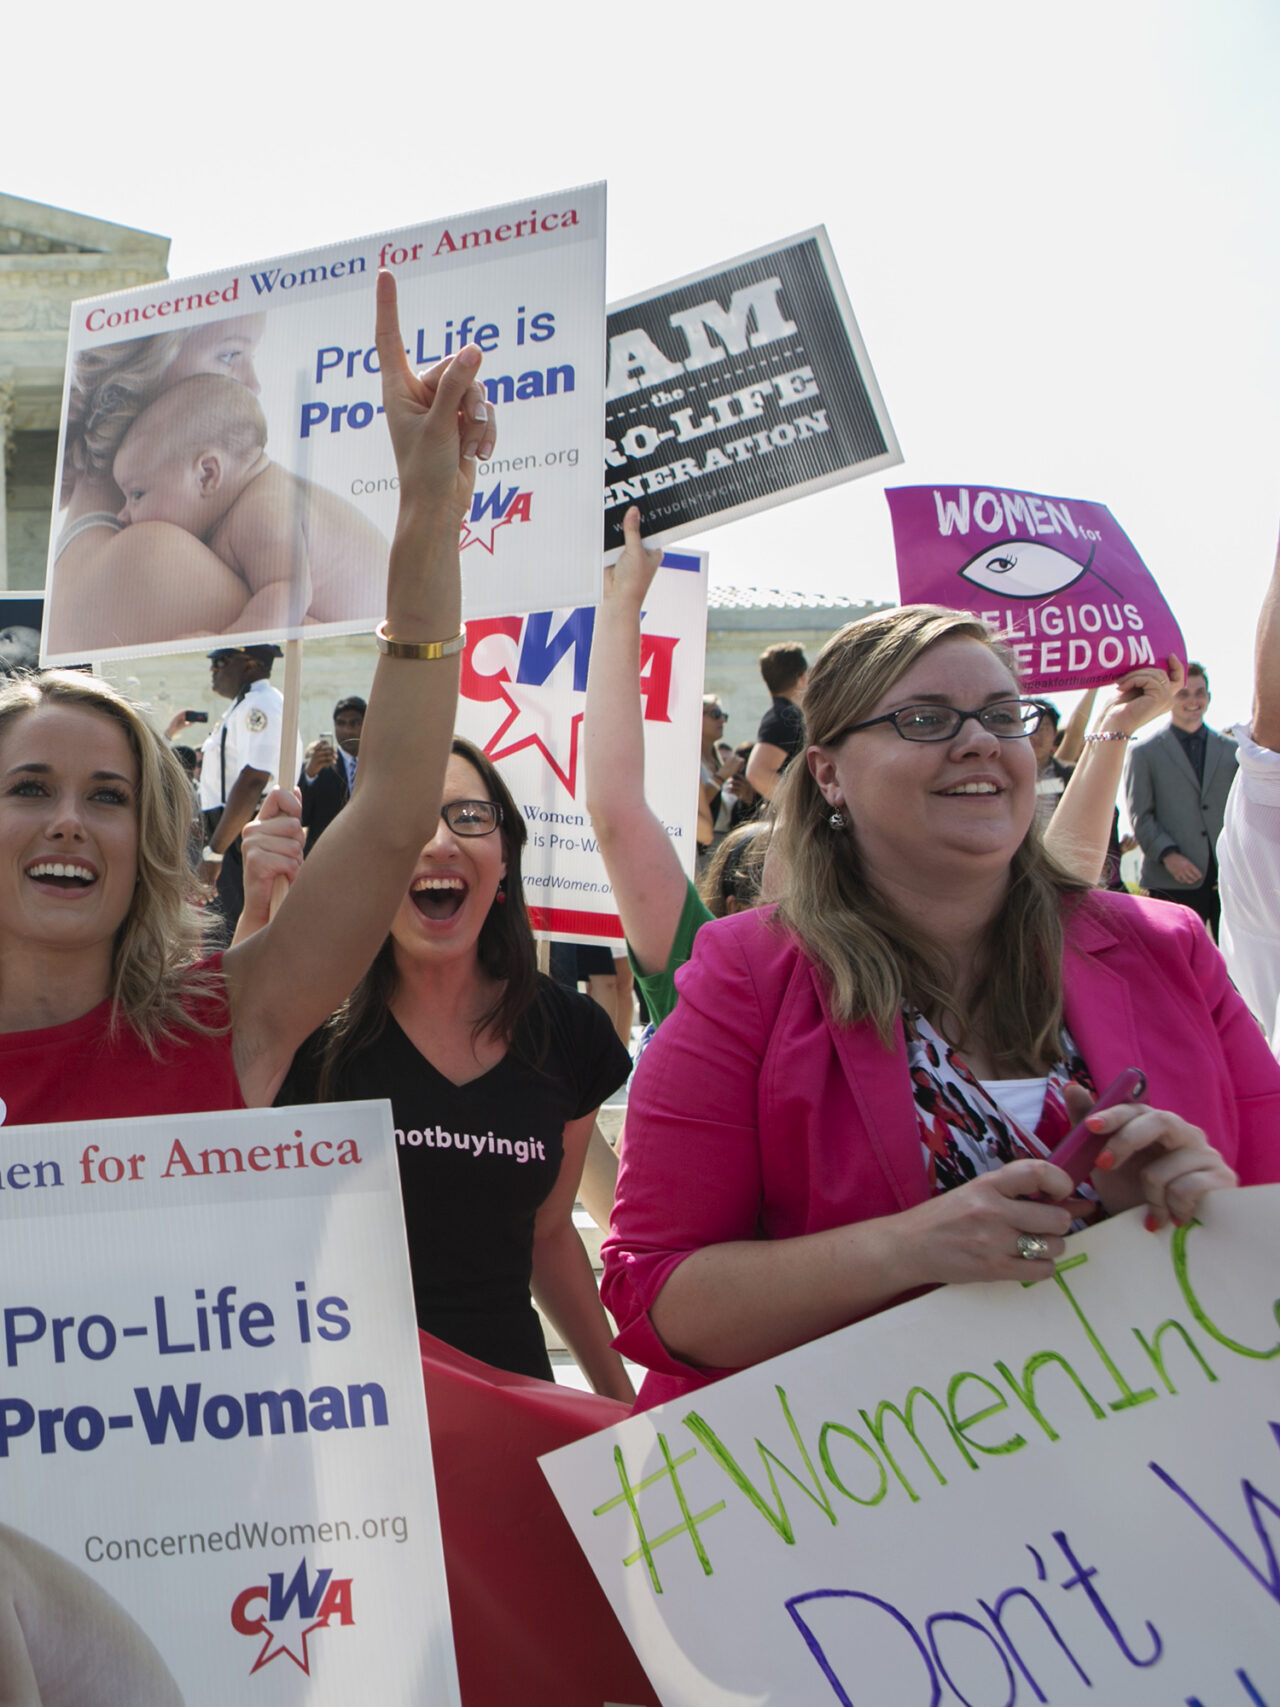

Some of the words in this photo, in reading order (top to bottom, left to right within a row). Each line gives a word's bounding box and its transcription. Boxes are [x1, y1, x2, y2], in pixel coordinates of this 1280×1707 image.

[85, 279, 240, 333] Concerned
[250, 255, 367, 296] Women
[377, 242, 423, 269] for
[432, 207, 580, 258] America
[517, 306, 556, 345] is
[606, 277, 798, 402] AM
[299, 363, 576, 438] Pro-man
[604, 364, 821, 470] RO-LIFE
[351, 447, 580, 496] Concomen.org
[604, 408, 830, 510] ENERATION
[461, 480, 533, 527] WA
[932, 487, 1078, 539] WOMEN
[1079, 522, 1103, 543] for
[981, 603, 1144, 639] ELIGIOUS
[1013, 635, 1156, 676] EEDOM
[523, 805, 584, 827] Women
[533, 832, 545, 848] is
[550, 834, 602, 854] Pro-W
[79, 1145, 145, 1185] for
[160, 1130, 363, 1179] America
[4, 1286, 276, 1367] Pro-Life
[295, 1281, 352, 1343] is
[593, 1218, 1280, 1594] #WomenInC
[84, 1515, 409, 1563] ConcernedWomen.org
[230, 1556, 356, 1636] CWA
[786, 1530, 1163, 1707] Don't
